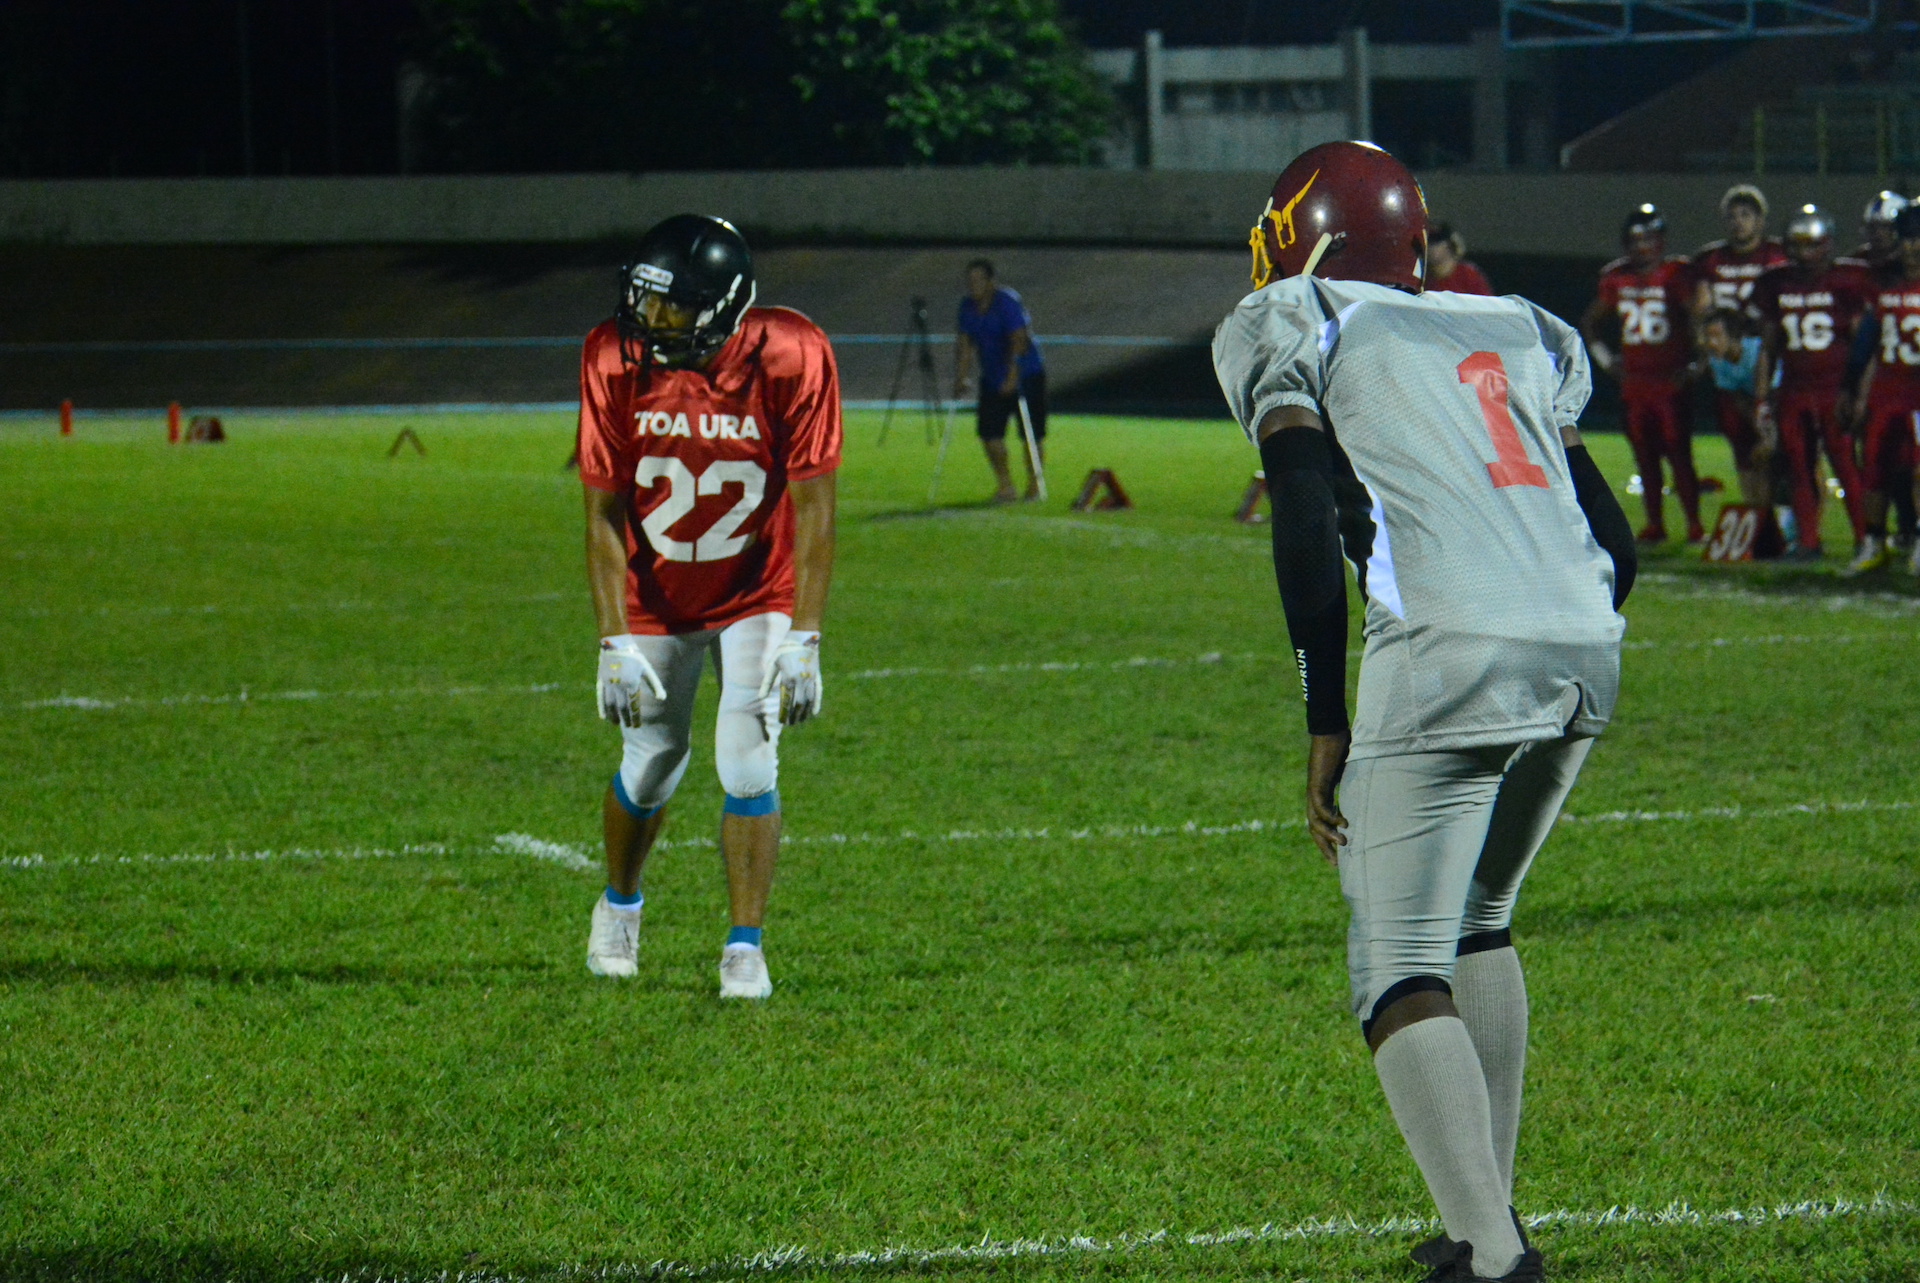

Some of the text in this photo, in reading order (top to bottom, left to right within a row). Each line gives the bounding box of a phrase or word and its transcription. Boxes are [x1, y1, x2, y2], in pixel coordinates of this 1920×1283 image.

[1617, 300, 1670, 344] 26
[1782, 312, 1835, 351] 16
[634, 410, 762, 440] TOA URA
[1456, 350, 1550, 488] 1
[635, 456, 768, 562] 22
